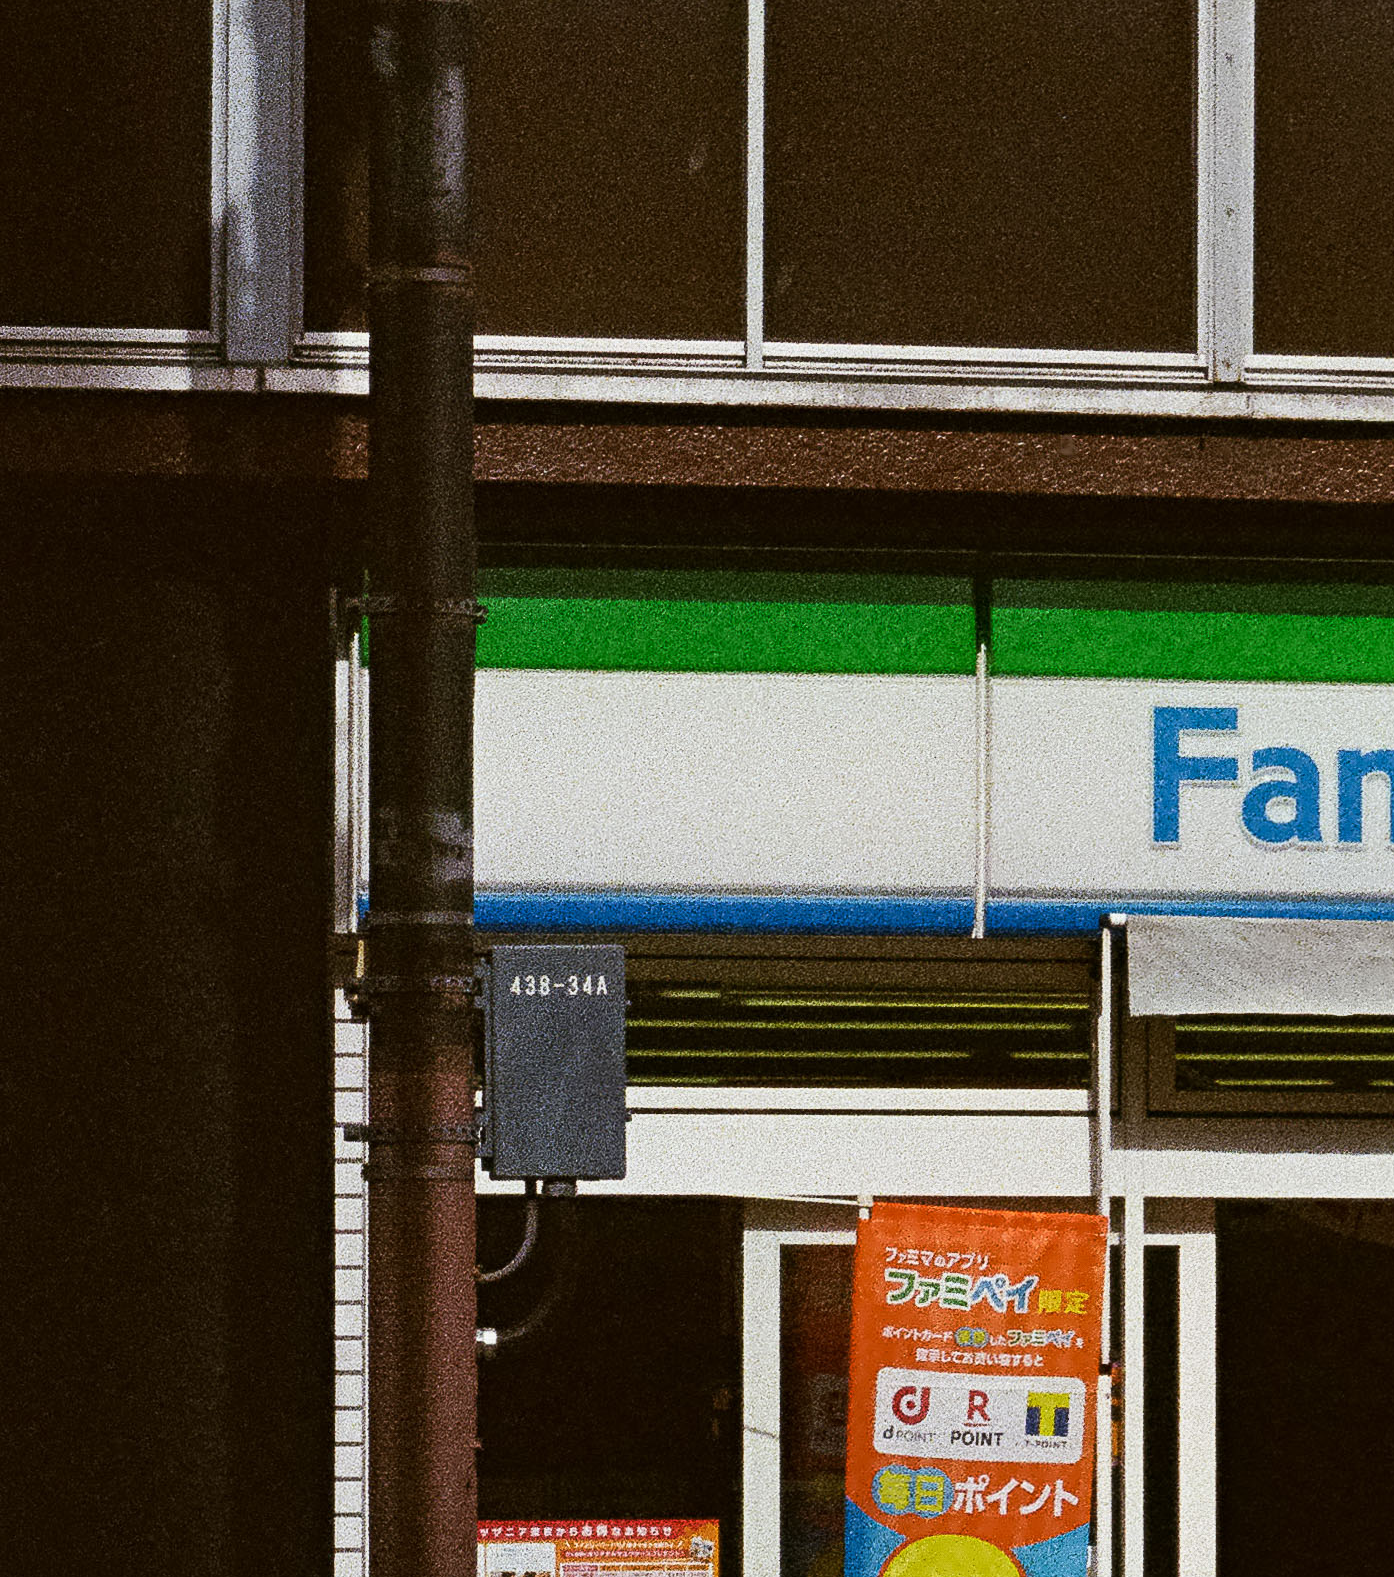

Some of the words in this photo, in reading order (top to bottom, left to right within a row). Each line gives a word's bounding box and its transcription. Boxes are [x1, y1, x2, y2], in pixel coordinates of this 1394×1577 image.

[510, 974, 608, 996] 438-34A
[884, 1246, 989, 1270] ファミマのアプリ
[950, 1429, 1004, 1447] POINT
[879, 1471, 1079, 1517] 毎日ポイント
